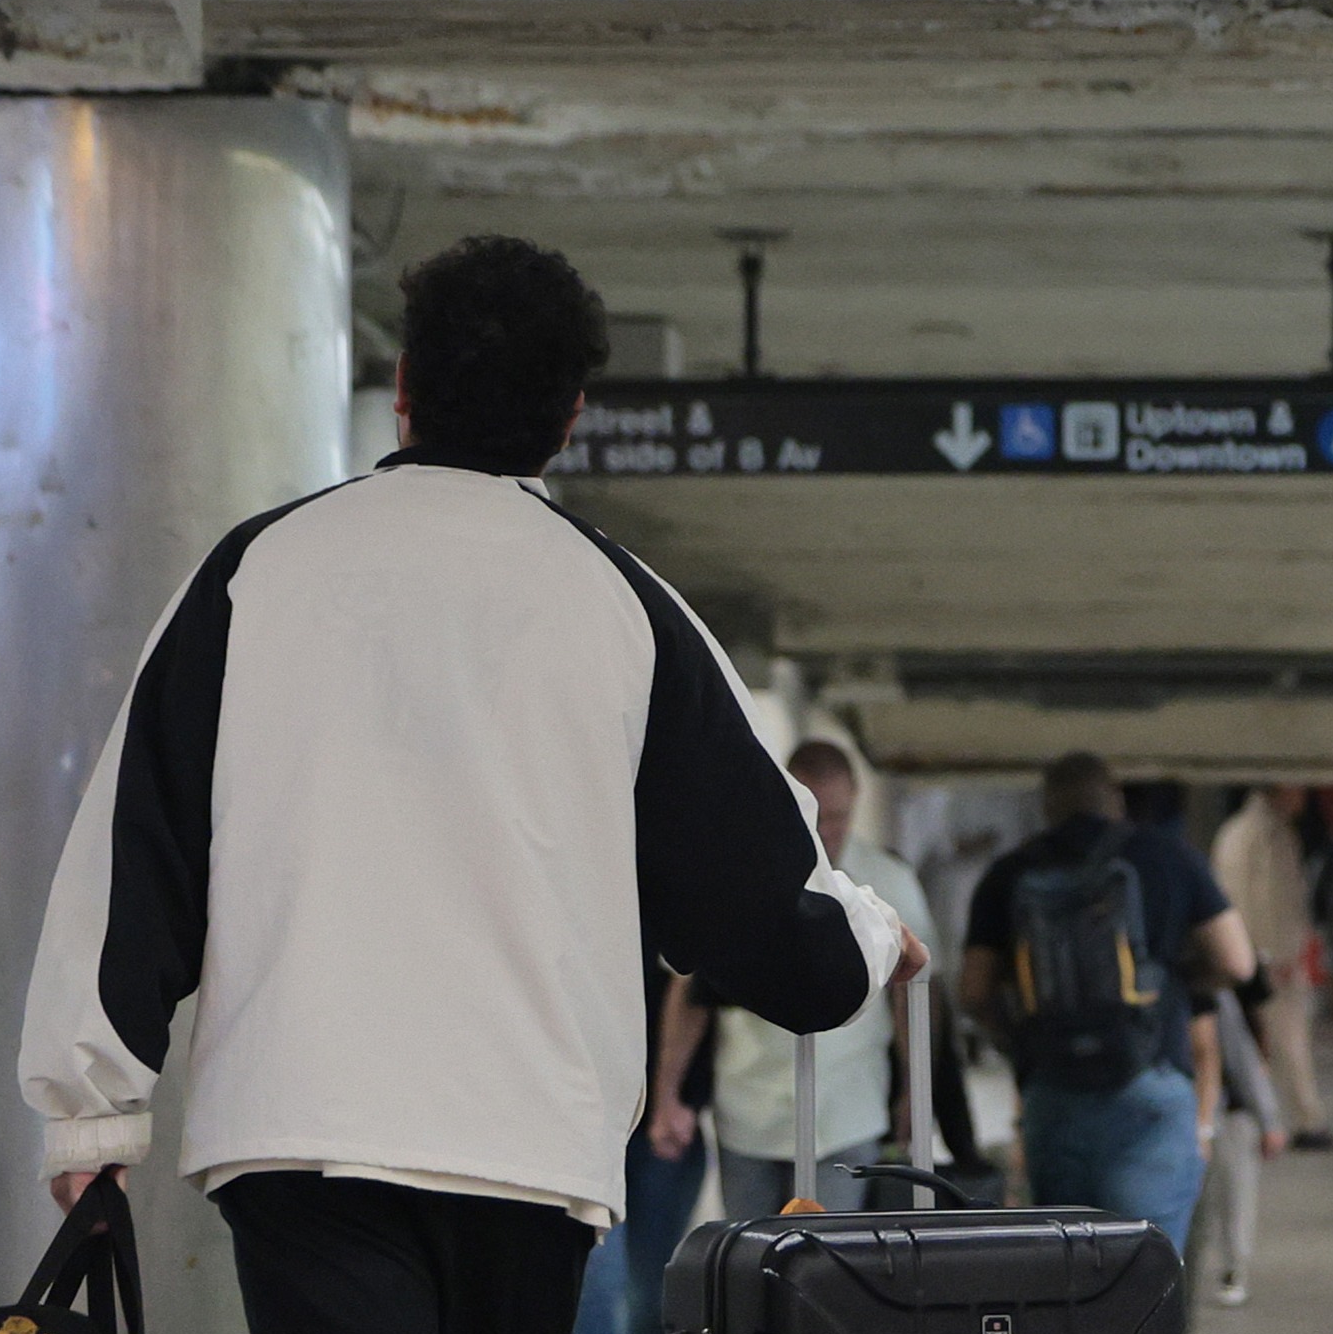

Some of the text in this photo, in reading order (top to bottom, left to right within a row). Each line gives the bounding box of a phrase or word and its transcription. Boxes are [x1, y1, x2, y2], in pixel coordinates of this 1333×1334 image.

[1125, 401, 1256, 440] Uptown
[687, 438, 725, 471] of
[777, 437, 823, 471] Av
[1126, 437, 1307, 471] Downtown
